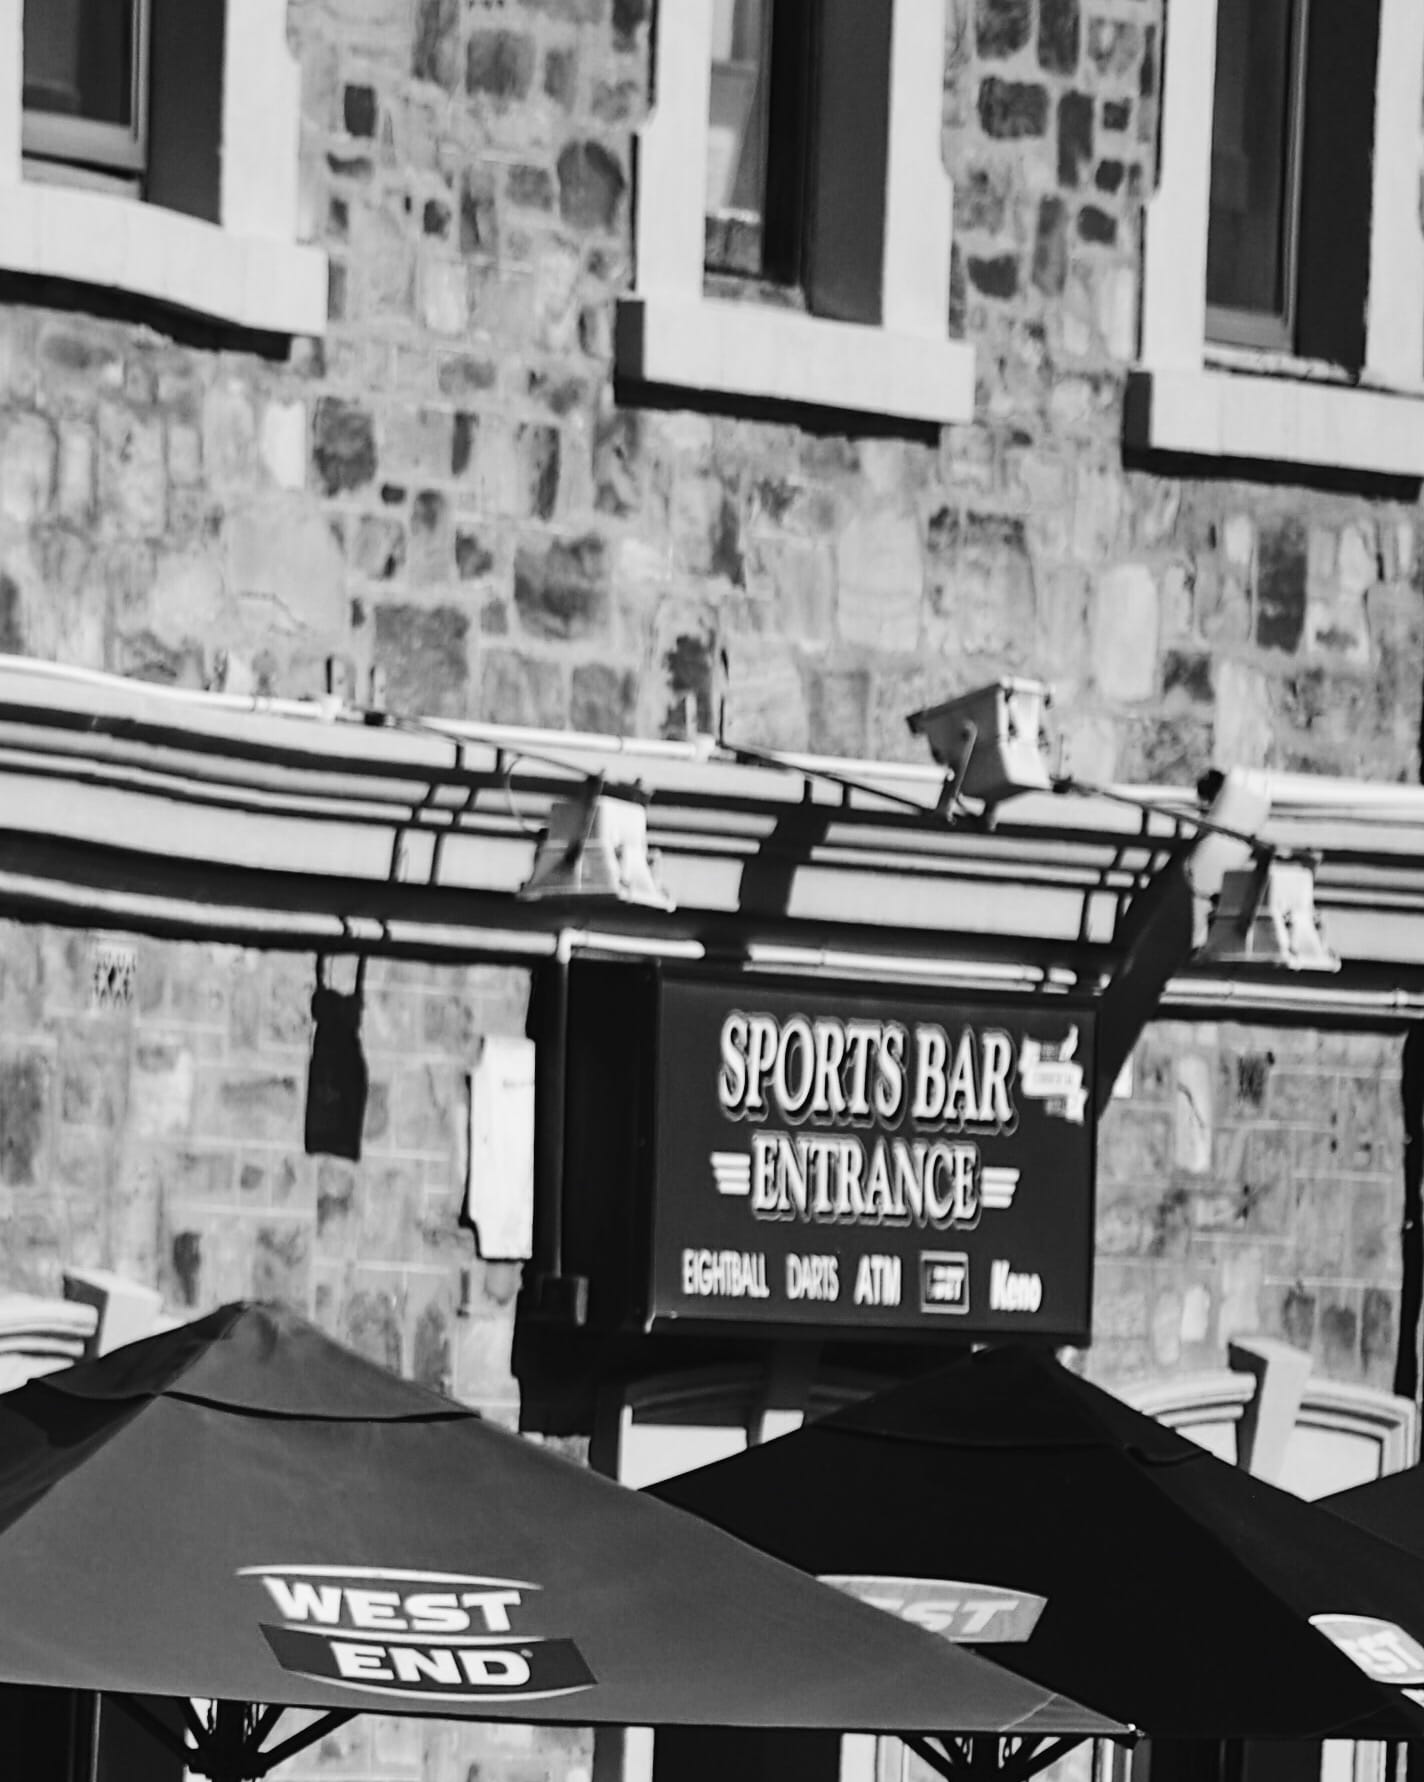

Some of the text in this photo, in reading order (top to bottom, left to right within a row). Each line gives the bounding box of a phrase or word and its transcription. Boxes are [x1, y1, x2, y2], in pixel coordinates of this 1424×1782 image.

[719, 1010, 1019, 1134] SPORTS BAR
[750, 1130, 982, 1230] ENTRANCE
[682, 1248, 771, 1298] EIGHTBALL
[785, 1253, 840, 1301] DARTS
[854, 1255, 902, 1306] ATM
[262, 1576, 522, 1633] WEST
[330, 1642, 531, 1687] END
